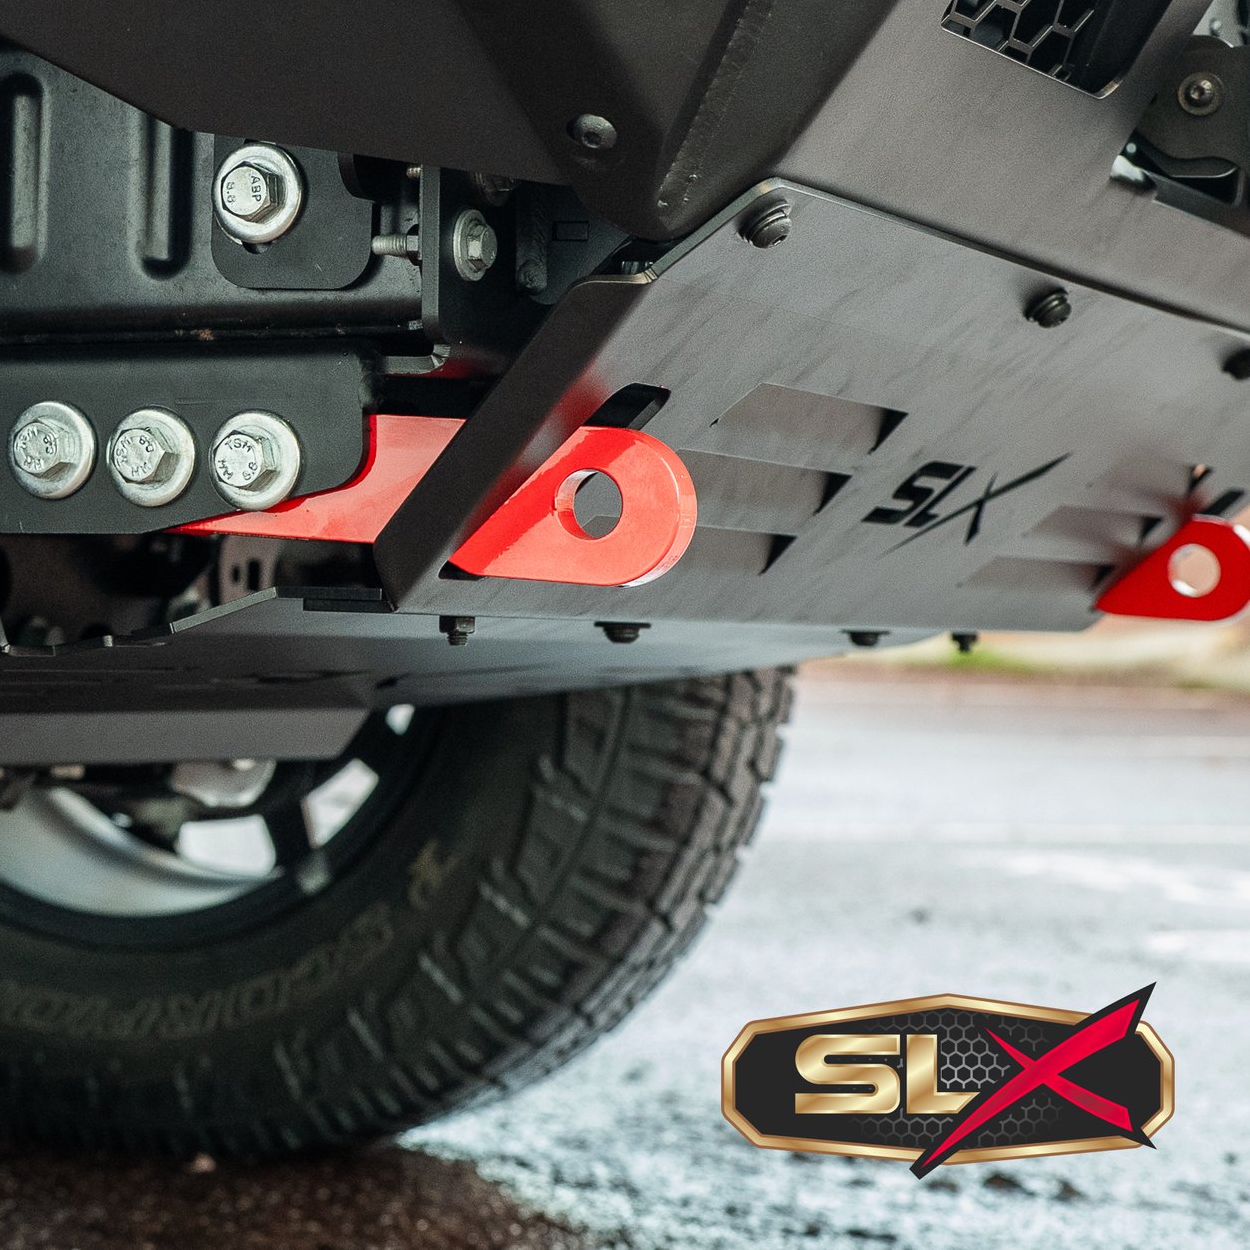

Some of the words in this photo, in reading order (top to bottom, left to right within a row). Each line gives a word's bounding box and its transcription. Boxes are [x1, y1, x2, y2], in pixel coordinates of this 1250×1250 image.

[251, 175, 263, 202] ABP
[225, 438, 253, 452] TSM
[861, 452, 1072, 558] SLX
